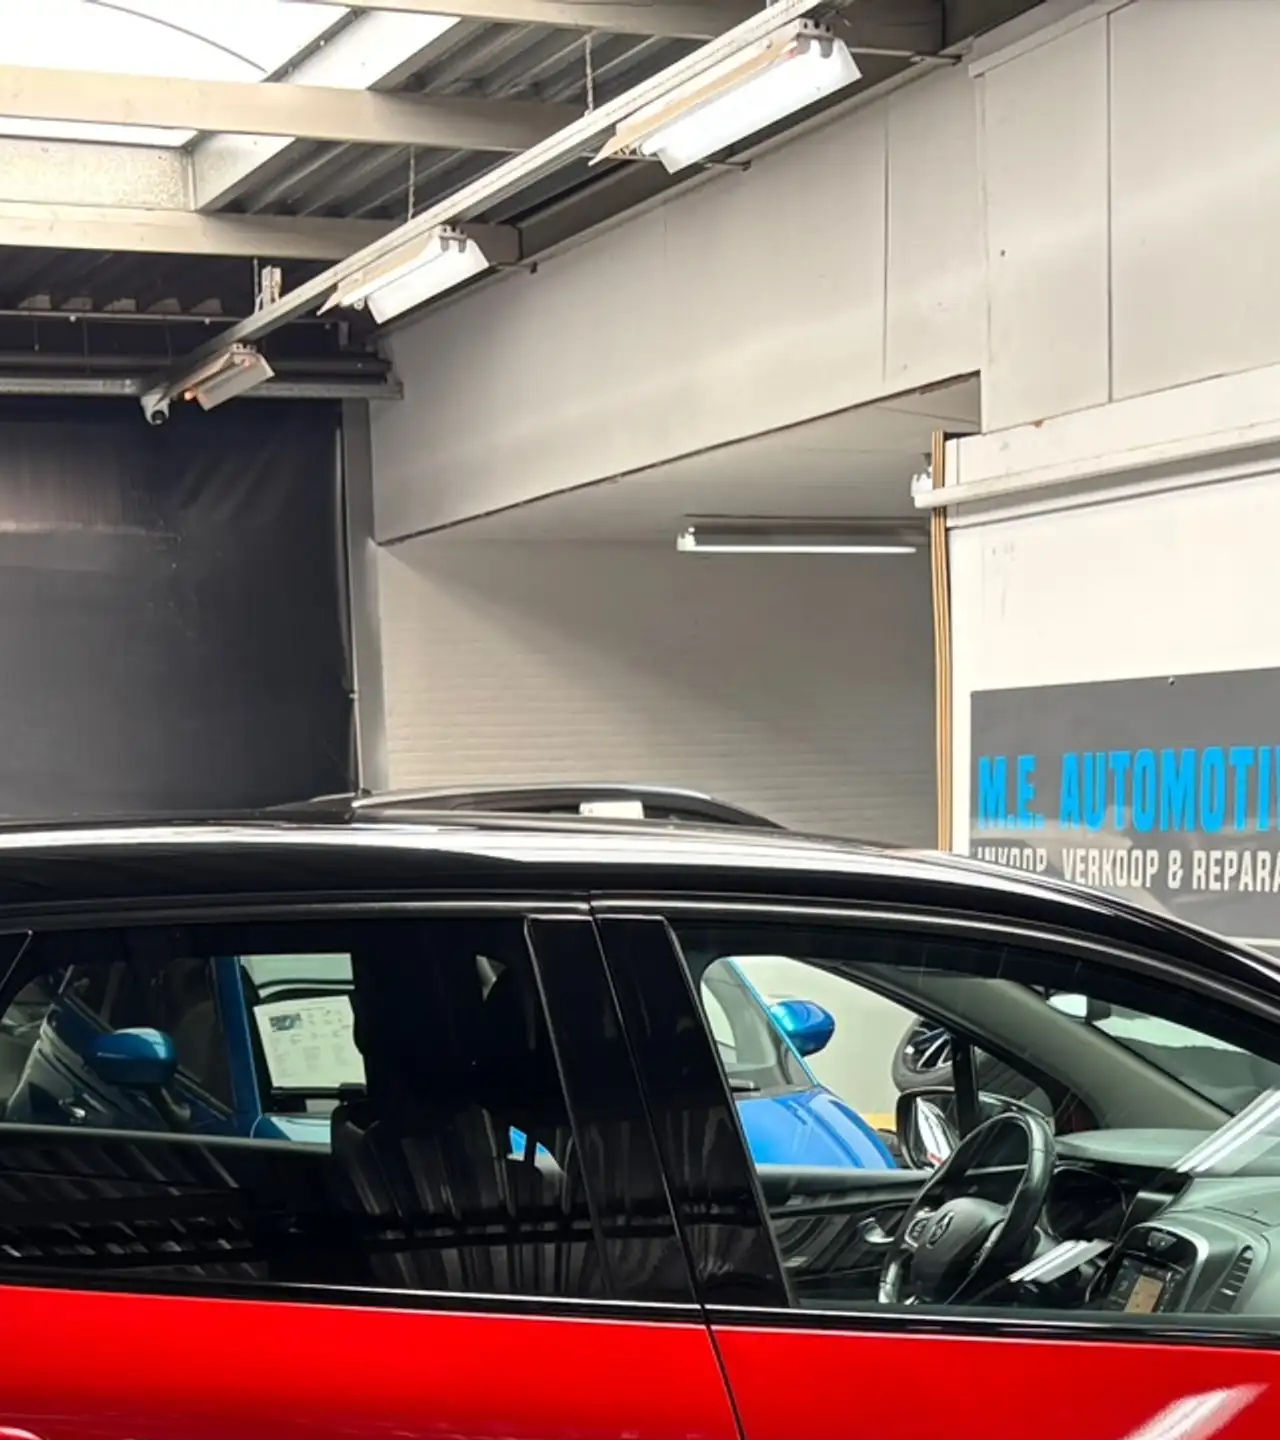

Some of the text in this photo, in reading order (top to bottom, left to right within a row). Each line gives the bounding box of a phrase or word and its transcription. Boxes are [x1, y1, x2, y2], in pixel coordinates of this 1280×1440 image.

[977, 756, 1045, 831] M.E.
[1062, 848, 1160, 889] VERKOOP
[1168, 849, 1184, 890] &
